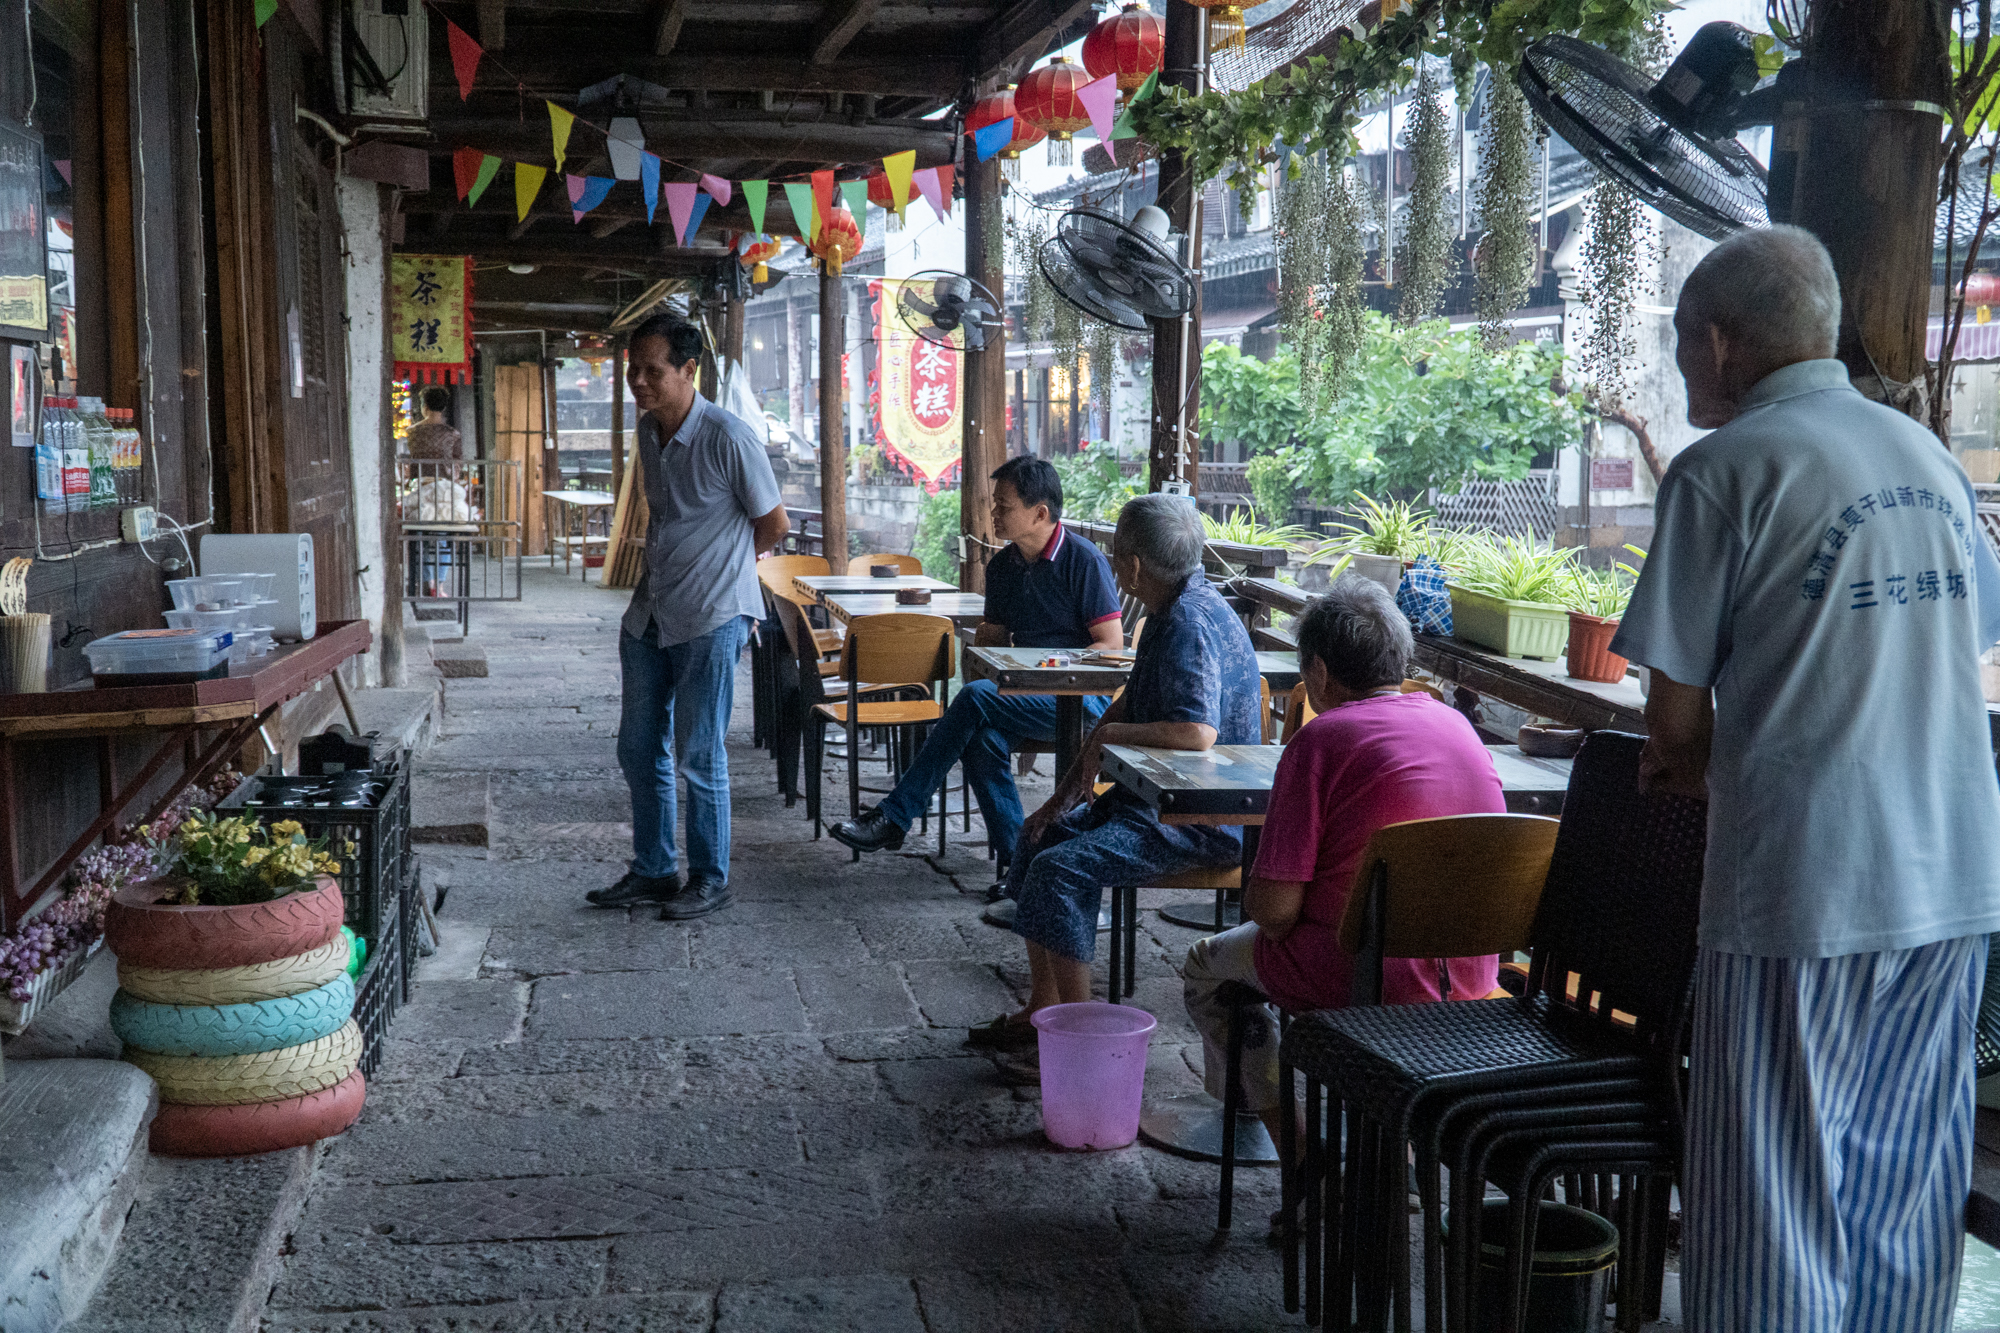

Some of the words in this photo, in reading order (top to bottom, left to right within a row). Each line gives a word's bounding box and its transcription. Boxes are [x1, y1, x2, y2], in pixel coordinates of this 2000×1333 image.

[410, 271, 443, 354] 茶糕
[888, 331, 905, 412] 匠心手作
[912, 339, 953, 419] 茶糕
[1849, 568, 1969, 610] 三花绿城
